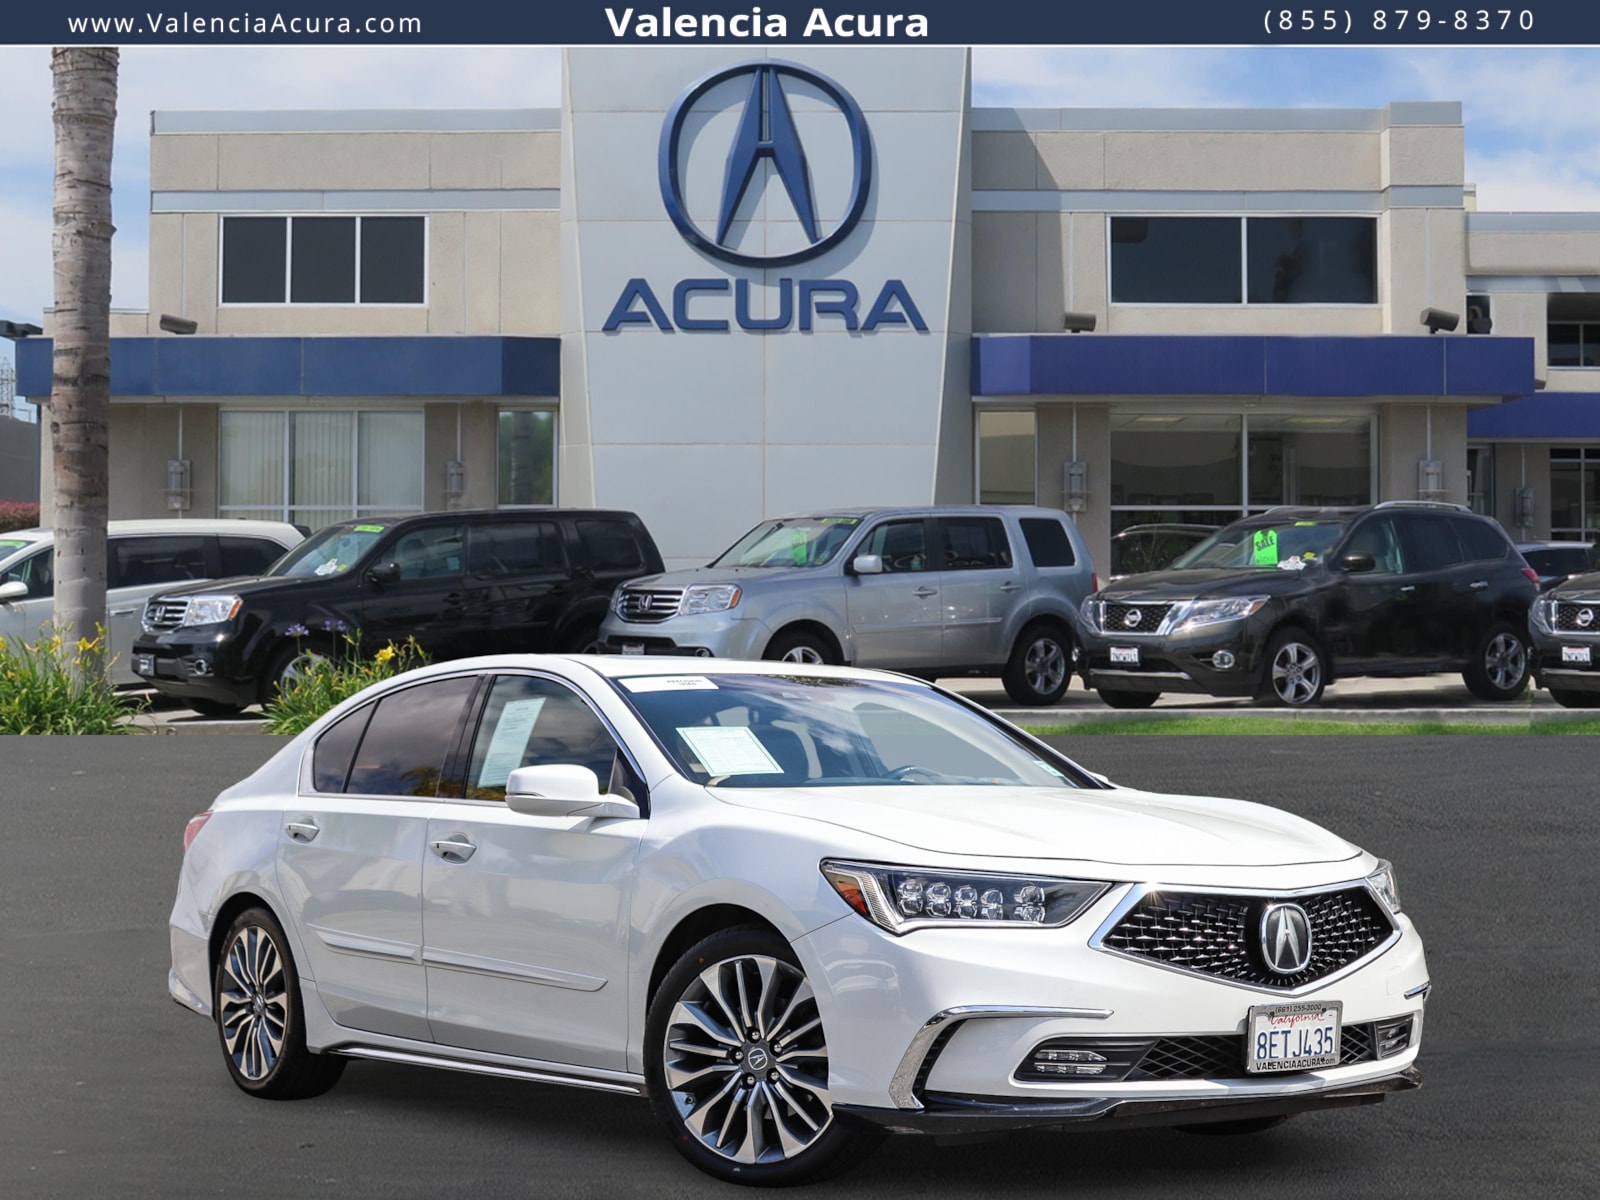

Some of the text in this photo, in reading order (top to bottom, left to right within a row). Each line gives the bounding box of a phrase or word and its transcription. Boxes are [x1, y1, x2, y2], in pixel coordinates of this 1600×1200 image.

[602, 278, 929, 332] ACURA
[1255, 535, 1275, 551] SALE
[1271, 1013, 1324, 1027] California
[1257, 1027, 1333, 1059] 8ETJ435
